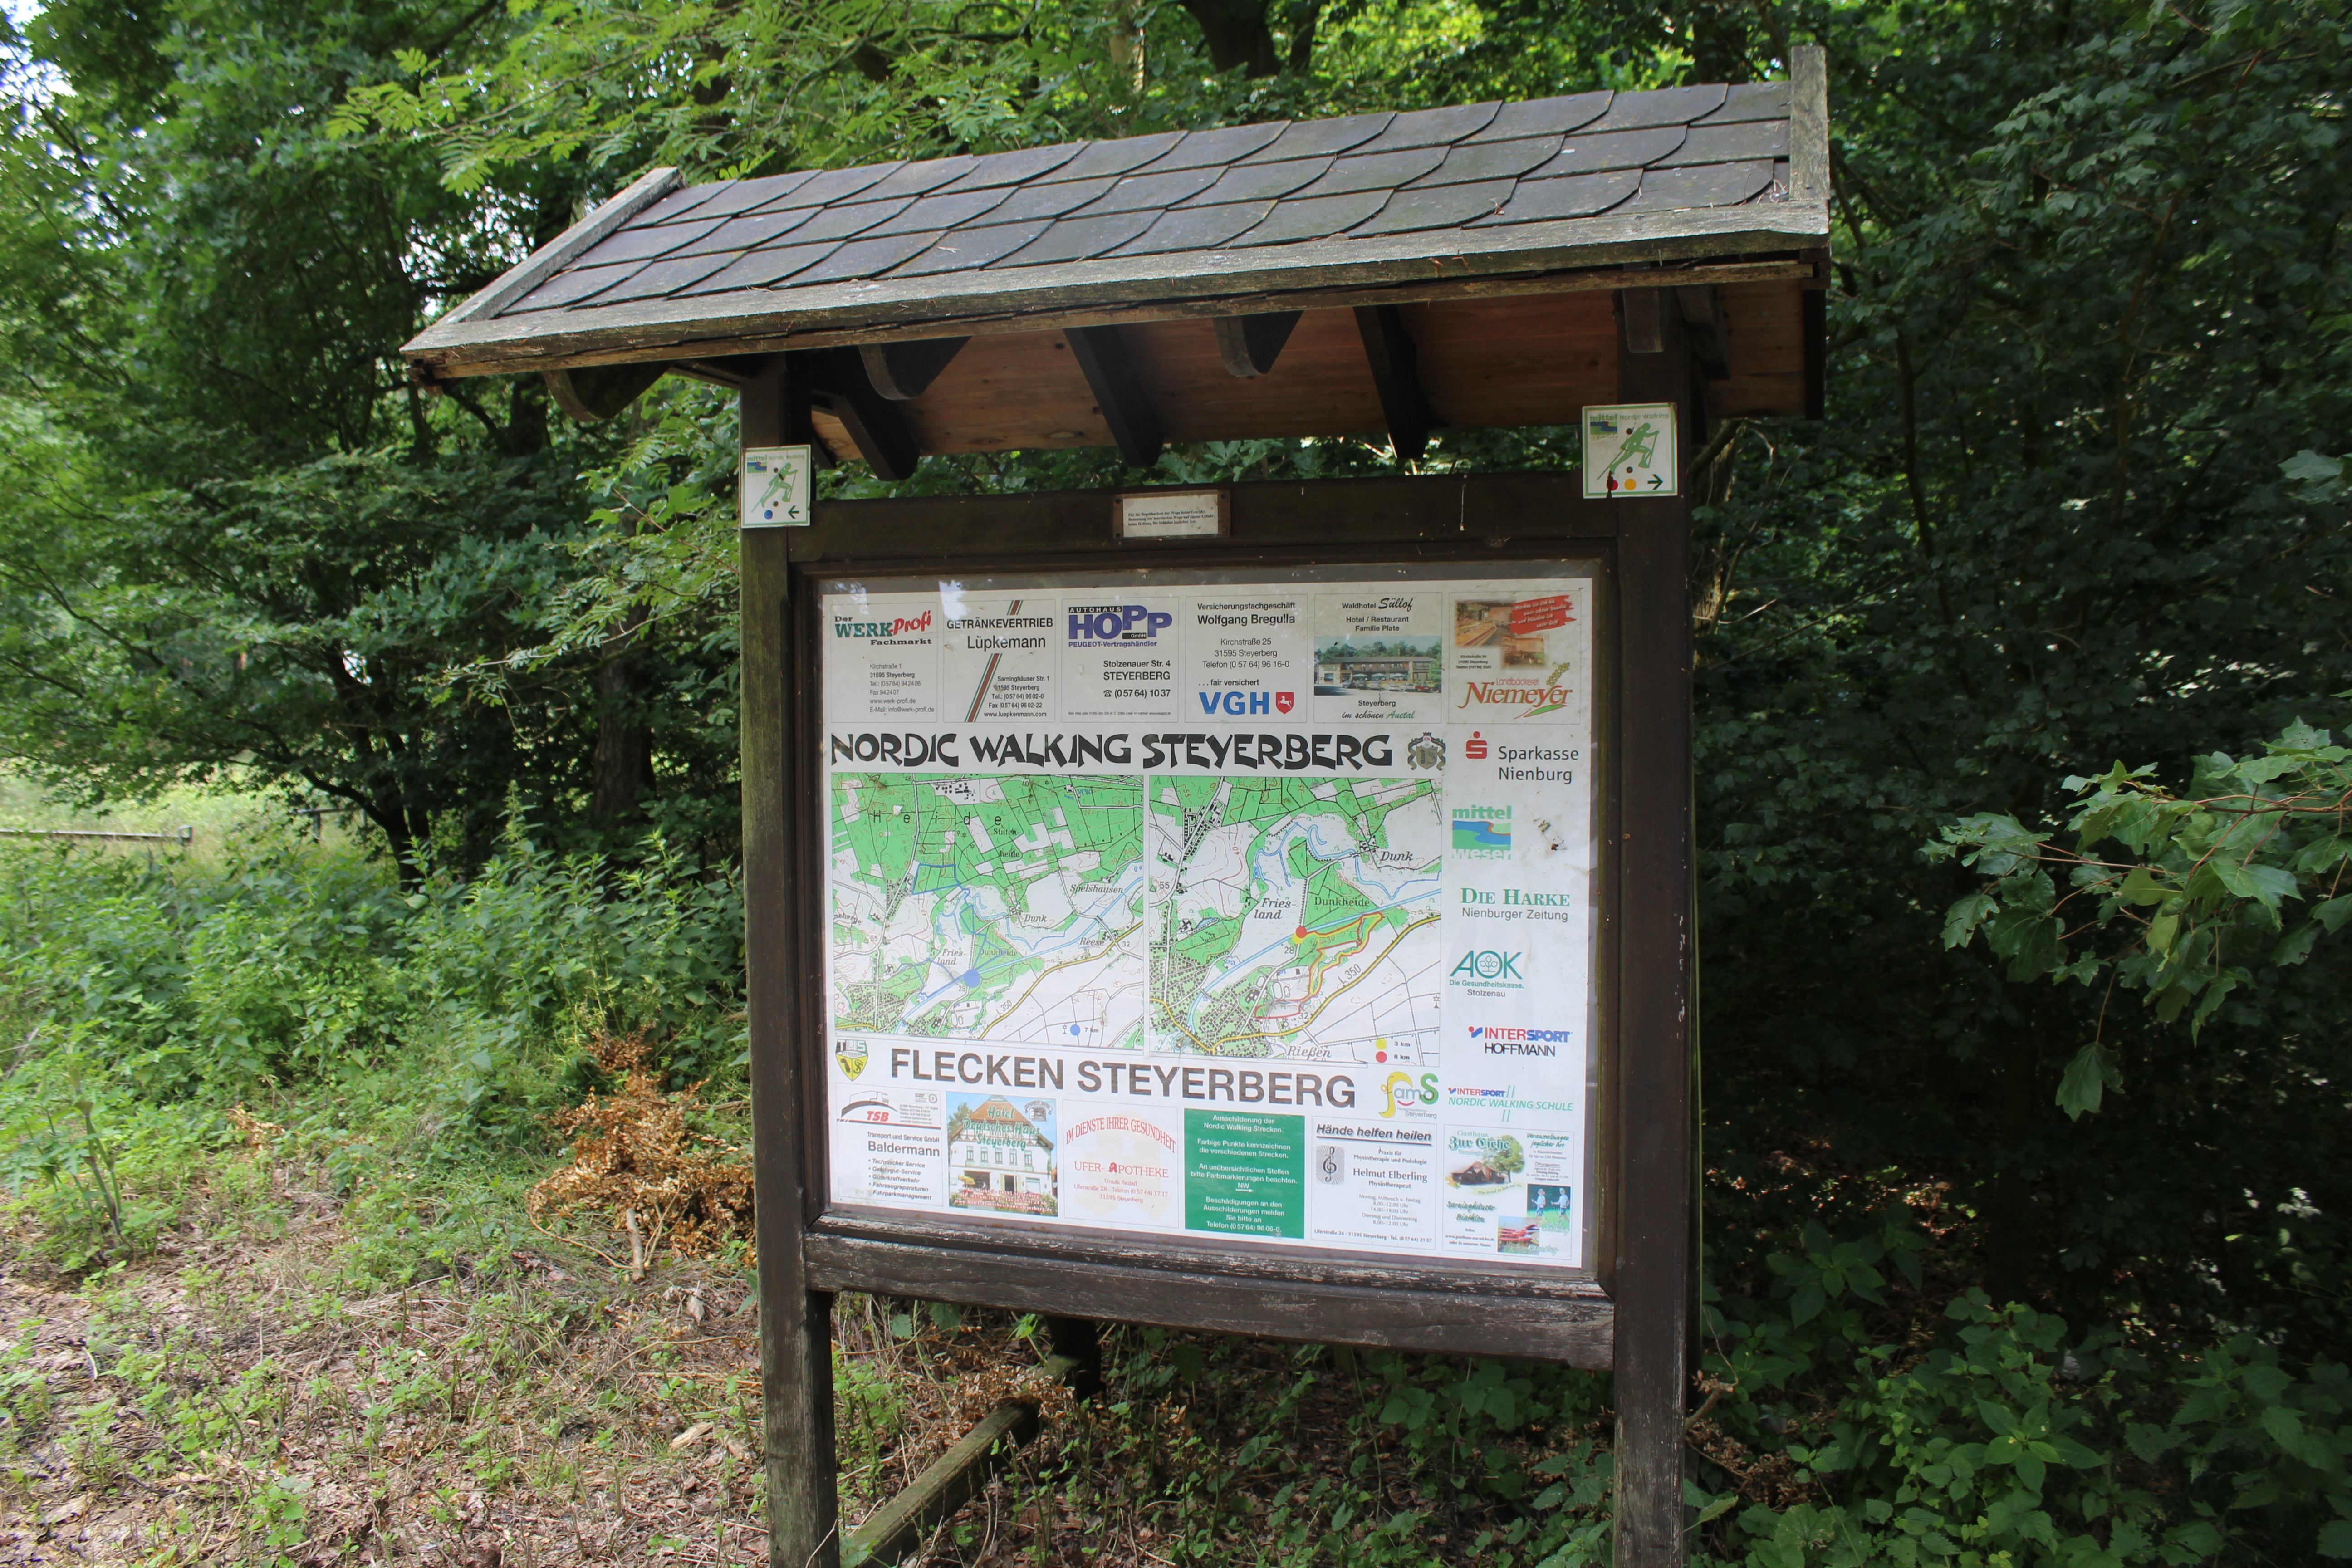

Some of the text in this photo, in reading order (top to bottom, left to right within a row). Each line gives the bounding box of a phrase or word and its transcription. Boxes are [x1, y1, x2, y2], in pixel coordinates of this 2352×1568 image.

[1197, 602, 1295, 611] Versicherungsfachgeschäft
[947, 617, 1053, 629] GETRÄNKEVERTRIEB
[1068, 605, 1172, 639] HOPP
[1197, 614, 1295, 627] Wolfgang Bregulla
[967, 635, 1046, 652] Lüpkemann
[1239, 649, 1277, 658] Steyerberg
[1103, 671, 1171, 681] STEYERBERG
[1457, 682, 1573, 708] Niemeyer
[1199, 691, 1269, 715] VGH
[1355, 710, 1384, 719] schönen
[831, 733, 1392, 770] NORDIC WALKING STEYERBERG
[1498, 746, 1579, 763] Sparkasse
[1499, 767, 1572, 784] Nienburg
[1452, 805, 1512, 819] mittel
[1381, 851, 1414, 862] Dunk
[1070, 885, 1123, 896] Spelshausen
[1024, 914, 1047, 922] Dunk
[1254, 909, 1283, 920] land
[1462, 907, 1568, 922] Nienburger Zeitung
[1079, 937, 1105, 946] Reese
[1449, 950, 1523, 980] AOK
[1467, 989, 1505, 997] Stolzenau
[1485, 1027, 1570, 1043] INTERSPORT
[1287, 1045, 1332, 1060] Rießen
[1485, 1043, 1556, 1057] HOFFMANN
[892, 1048, 1355, 1108] FLECKEN STEYERBERG
[1449, 1097, 1573, 1111] NORDIC WALKING SCHULE
[867, 1111, 889, 1122] TSB
[987, 1106, 1014, 1119] Hotel
[1405, 1111, 1437, 1119] Steyerberg
[1213, 1115, 1262, 1125] Ausschilderung
[963, 1118, 1040, 1135] Deutsches Haus
[1226, 1124, 1252, 1132] Walking
[1316, 1124, 1431, 1141] Hände helfen heilen
[867, 1132, 892, 1140] Transport
[1066, 1117, 1176, 1154] IM DIENSTE IHRER GESUNDHEIT
[976, 1134, 1027, 1151] Steyerberg
[1197, 1138, 1221, 1147] Farbige
[1246, 1142, 1291, 1150] kennzeichnen
[1448, 1136, 1511, 1151] Zur Eiche
[868, 1141, 940, 1157] Baldermann
[1210, 1148, 1257, 1156] verschiedenen
[1258, 1151, 1289, 1159] Strecken.
[1353, 1155, 1390, 1163] Physiotherapie
[1209, 1164, 1265, 1174] unübersichtlichen
[1206, 1172, 1265, 1182] Farbmarkierungen
[1353, 1168, 1428, 1183] Helmut Elberling
[872, 1182, 929, 1192] Fahrzeugreparaturen
[1368, 1181, 1411, 1190] Physiotherapeut
[873, 1190, 932, 1200] Fuhrparkmanagement
[1117, 1196, 1143, 1204] Steyerberg
[1206, 1196, 1259, 1207] Beschädigungen
[1203, 1205, 1260, 1215] Ausschilderungen
